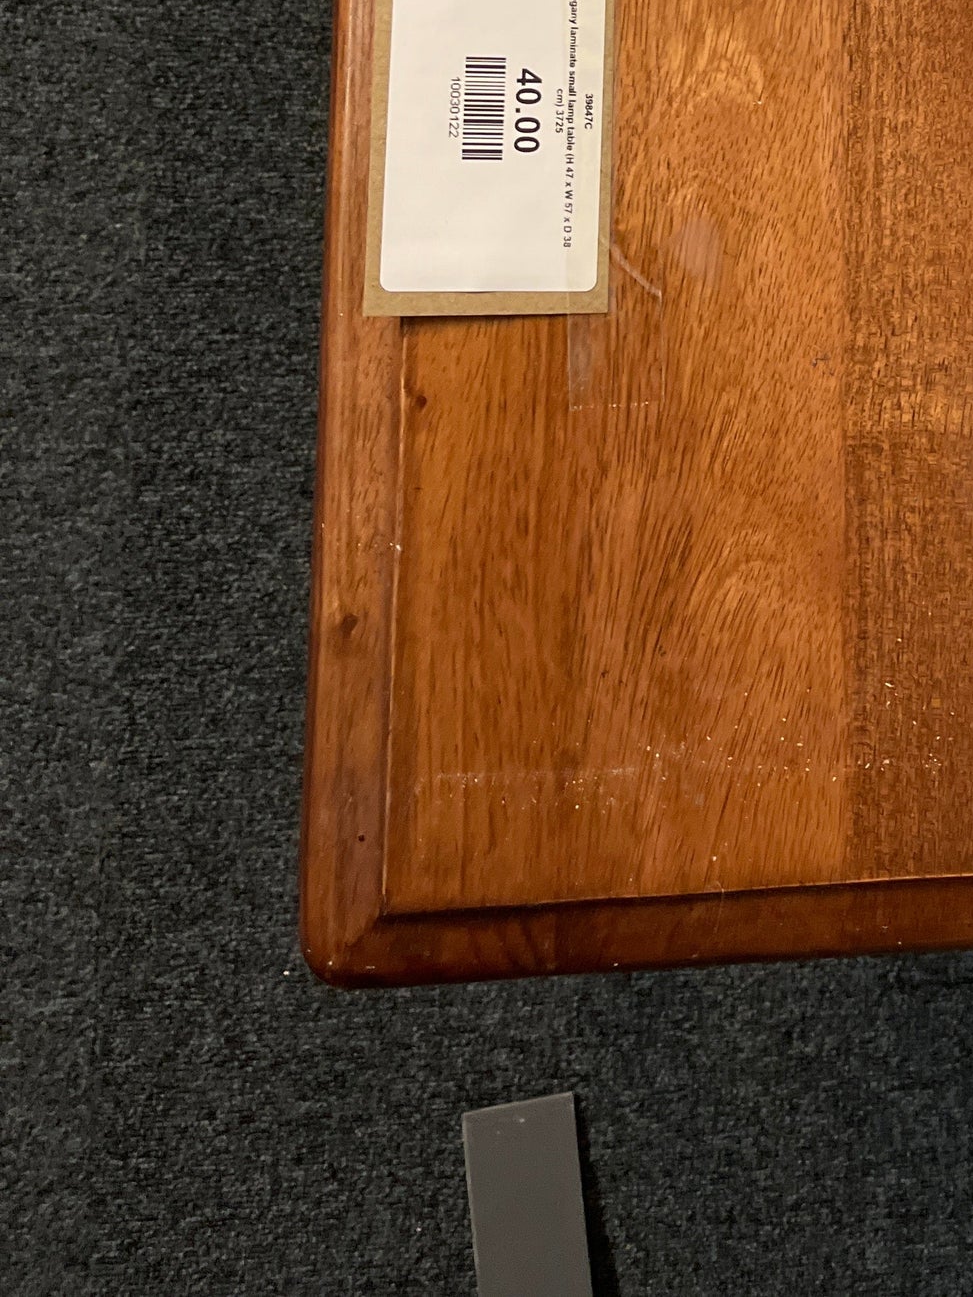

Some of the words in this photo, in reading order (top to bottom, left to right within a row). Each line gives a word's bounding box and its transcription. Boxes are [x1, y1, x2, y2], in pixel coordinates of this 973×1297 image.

[569, 26, 579, 68] laminate
[568, 70, 577, 97] small
[448, 76, 462, 139] 10030122
[513, 67, 543, 153] 40.00
[553, 88, 565, 108] cm)
[554, 110, 565, 134] 3725
[565, 99, 577, 124] lamp
[584, 93, 594, 130] 39847C
[566, 126, 576, 152] table
[564, 153, 575, 165] (H
[565, 166, 574, 179] 47
[564, 189, 574, 200] W
[563, 202, 574, 215] 57
[563, 225, 573, 234] D
[562, 236, 572, 248] 38
